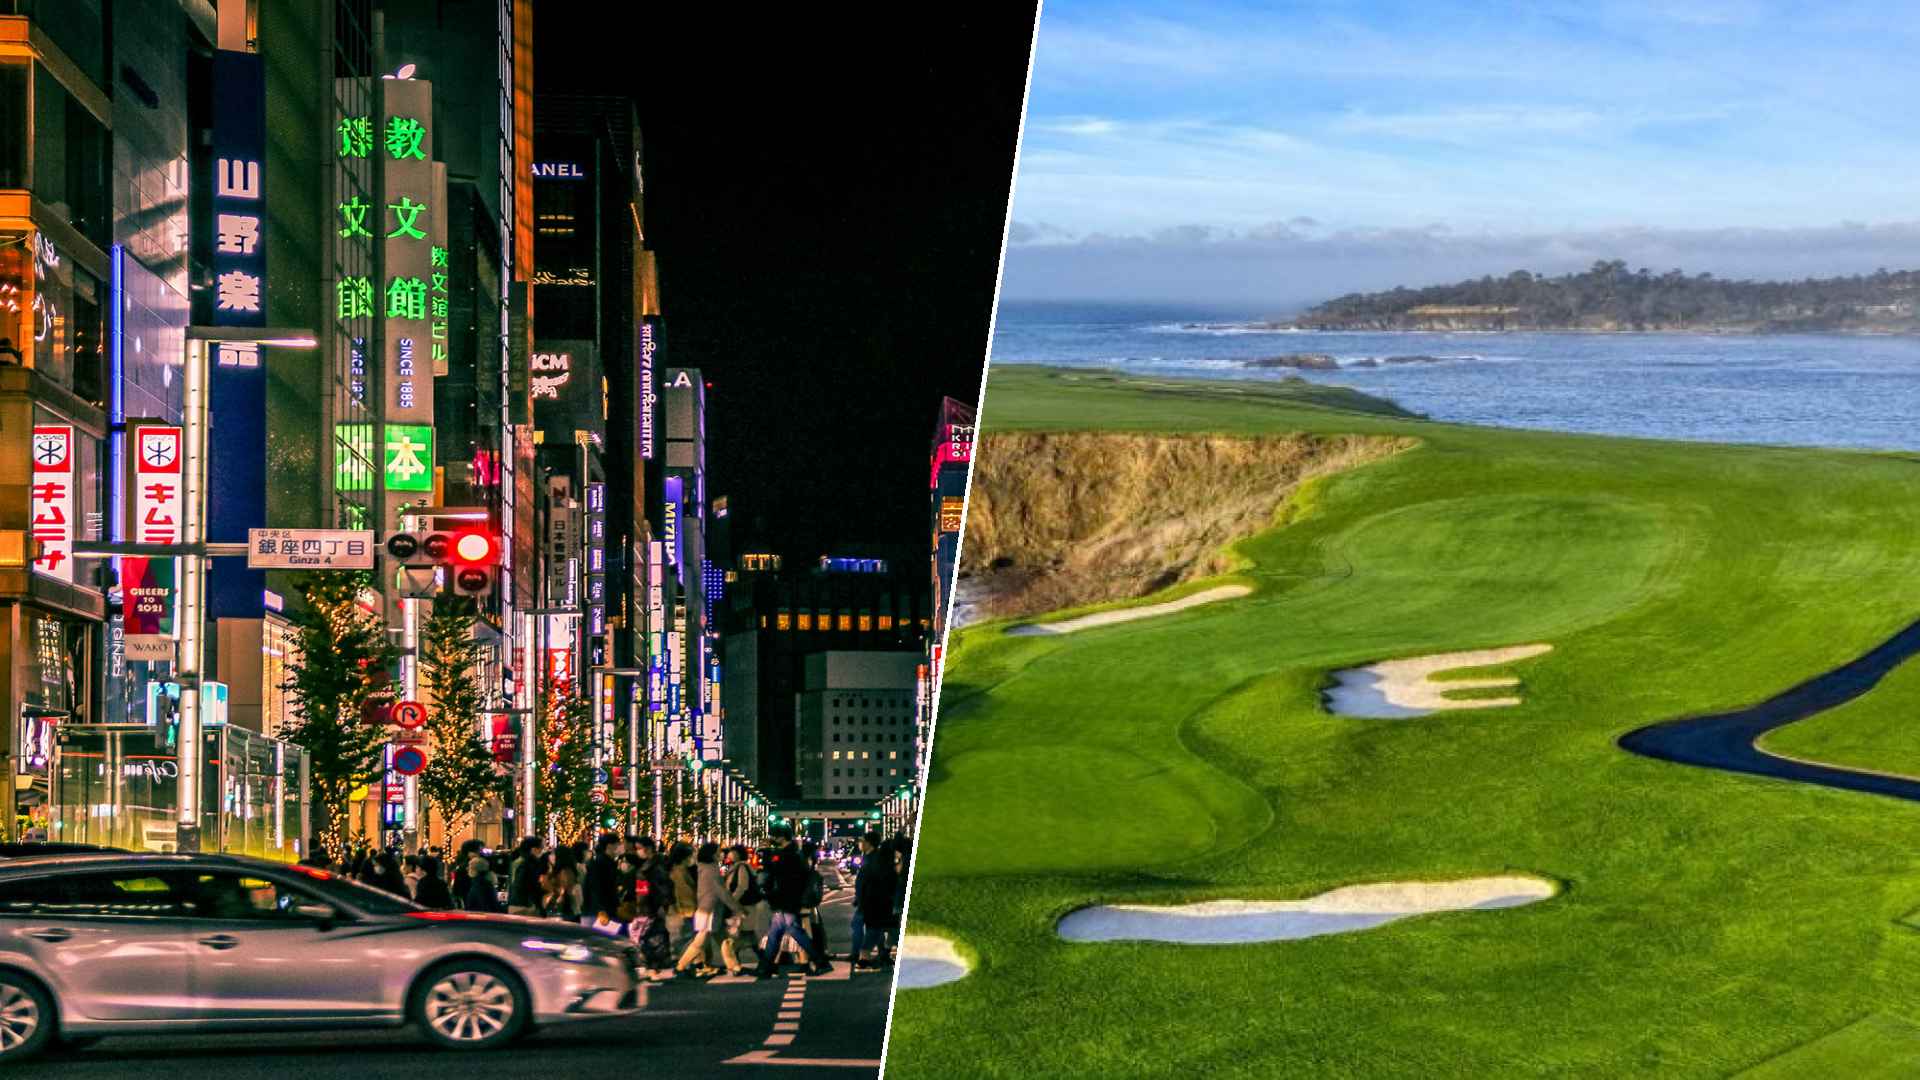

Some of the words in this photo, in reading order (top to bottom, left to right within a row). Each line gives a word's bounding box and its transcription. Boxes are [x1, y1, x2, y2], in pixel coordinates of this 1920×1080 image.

[530, 163, 583, 176] ANEL
[384, 115, 428, 320] 教文館
[400, 338, 413, 376] SINCE
[400, 381, 413, 409] 1885
[387, 436, 426, 481] 本
[144, 483, 175, 545] キムラ
[258, 530, 292, 538] 中央区
[258, 539, 365, 556] 銀座四丁目
[288, 556, 320, 565] Ginza
[324, 556, 332, 565] 4
[130, 587, 169, 596] CHEERS
[137, 604, 163, 613] 2021
[133, 642, 168, 652] WAKO
